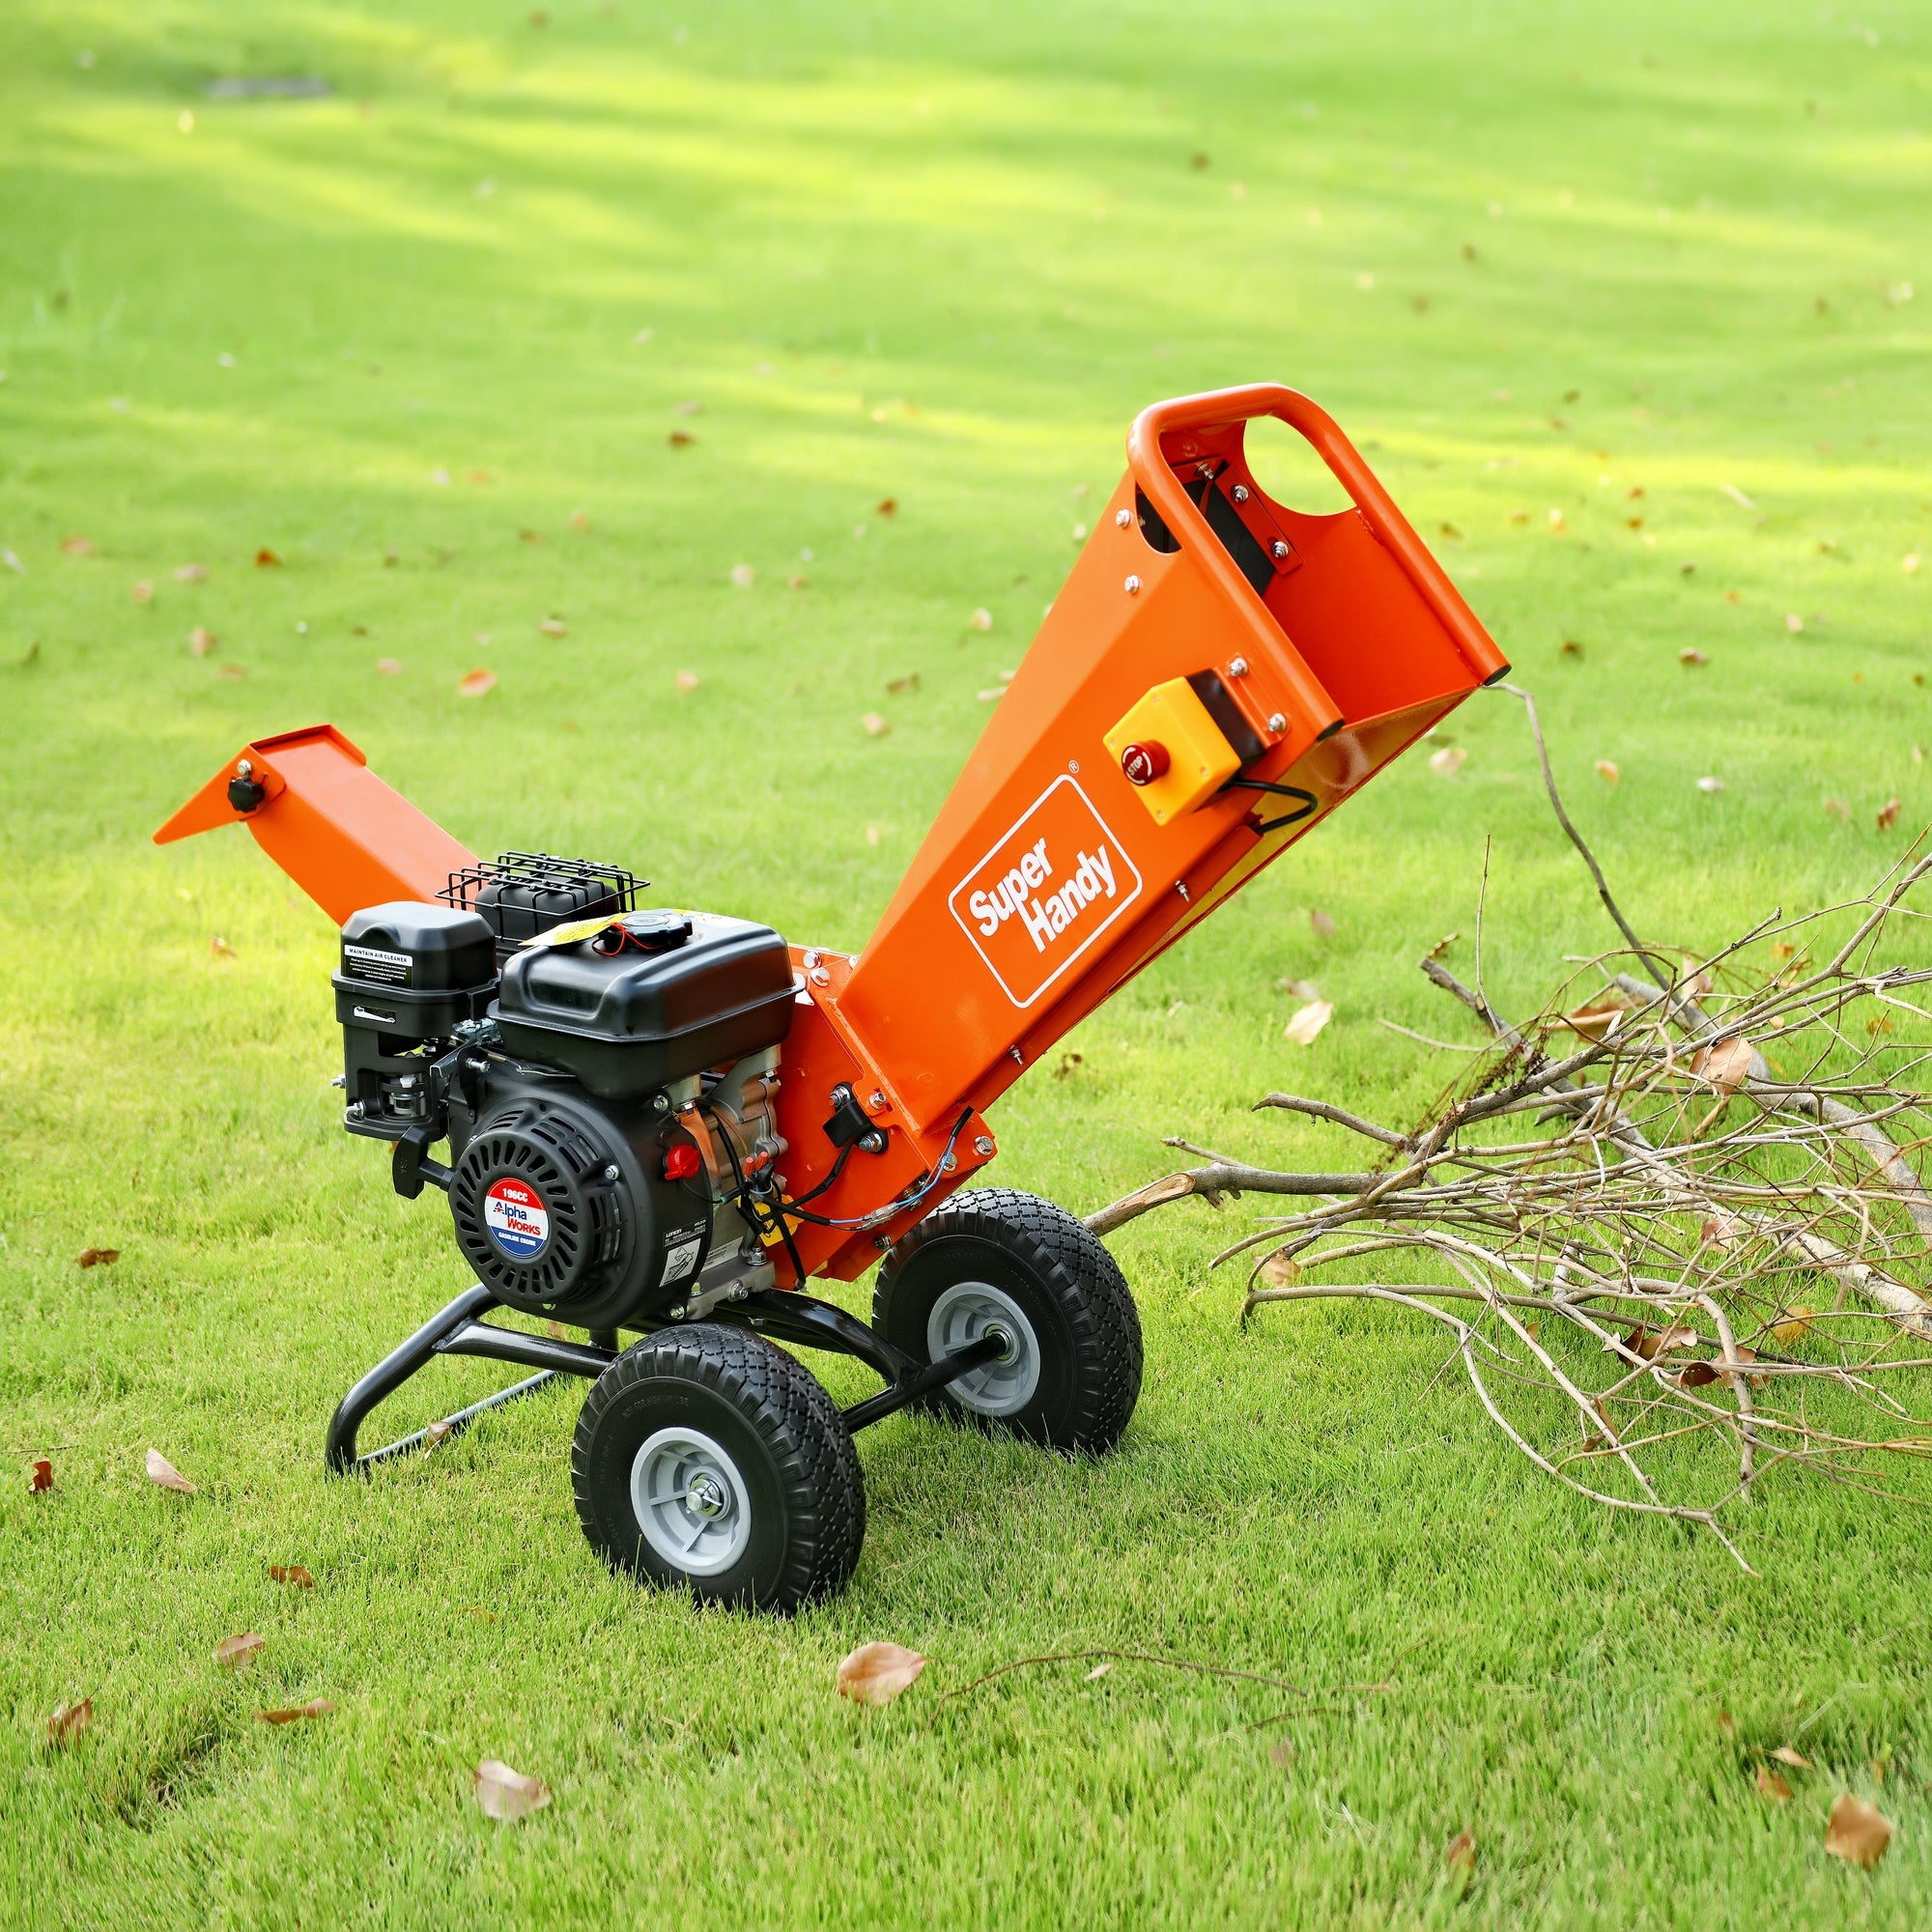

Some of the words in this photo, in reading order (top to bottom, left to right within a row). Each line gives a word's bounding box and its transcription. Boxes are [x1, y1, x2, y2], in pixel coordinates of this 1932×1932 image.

[1127, 755, 1143, 776] STOP
[969, 837, 1053, 937] Super
[1014, 844, 1117, 953] Handy
[349, 948, 374, 956] MAINTAIN
[384, 954, 408, 963] CLEANER
[502, 1187, 527, 1202] 196CC
[493, 1201, 527, 1220] Alpha
[507, 1217, 541, 1236] WORKS
